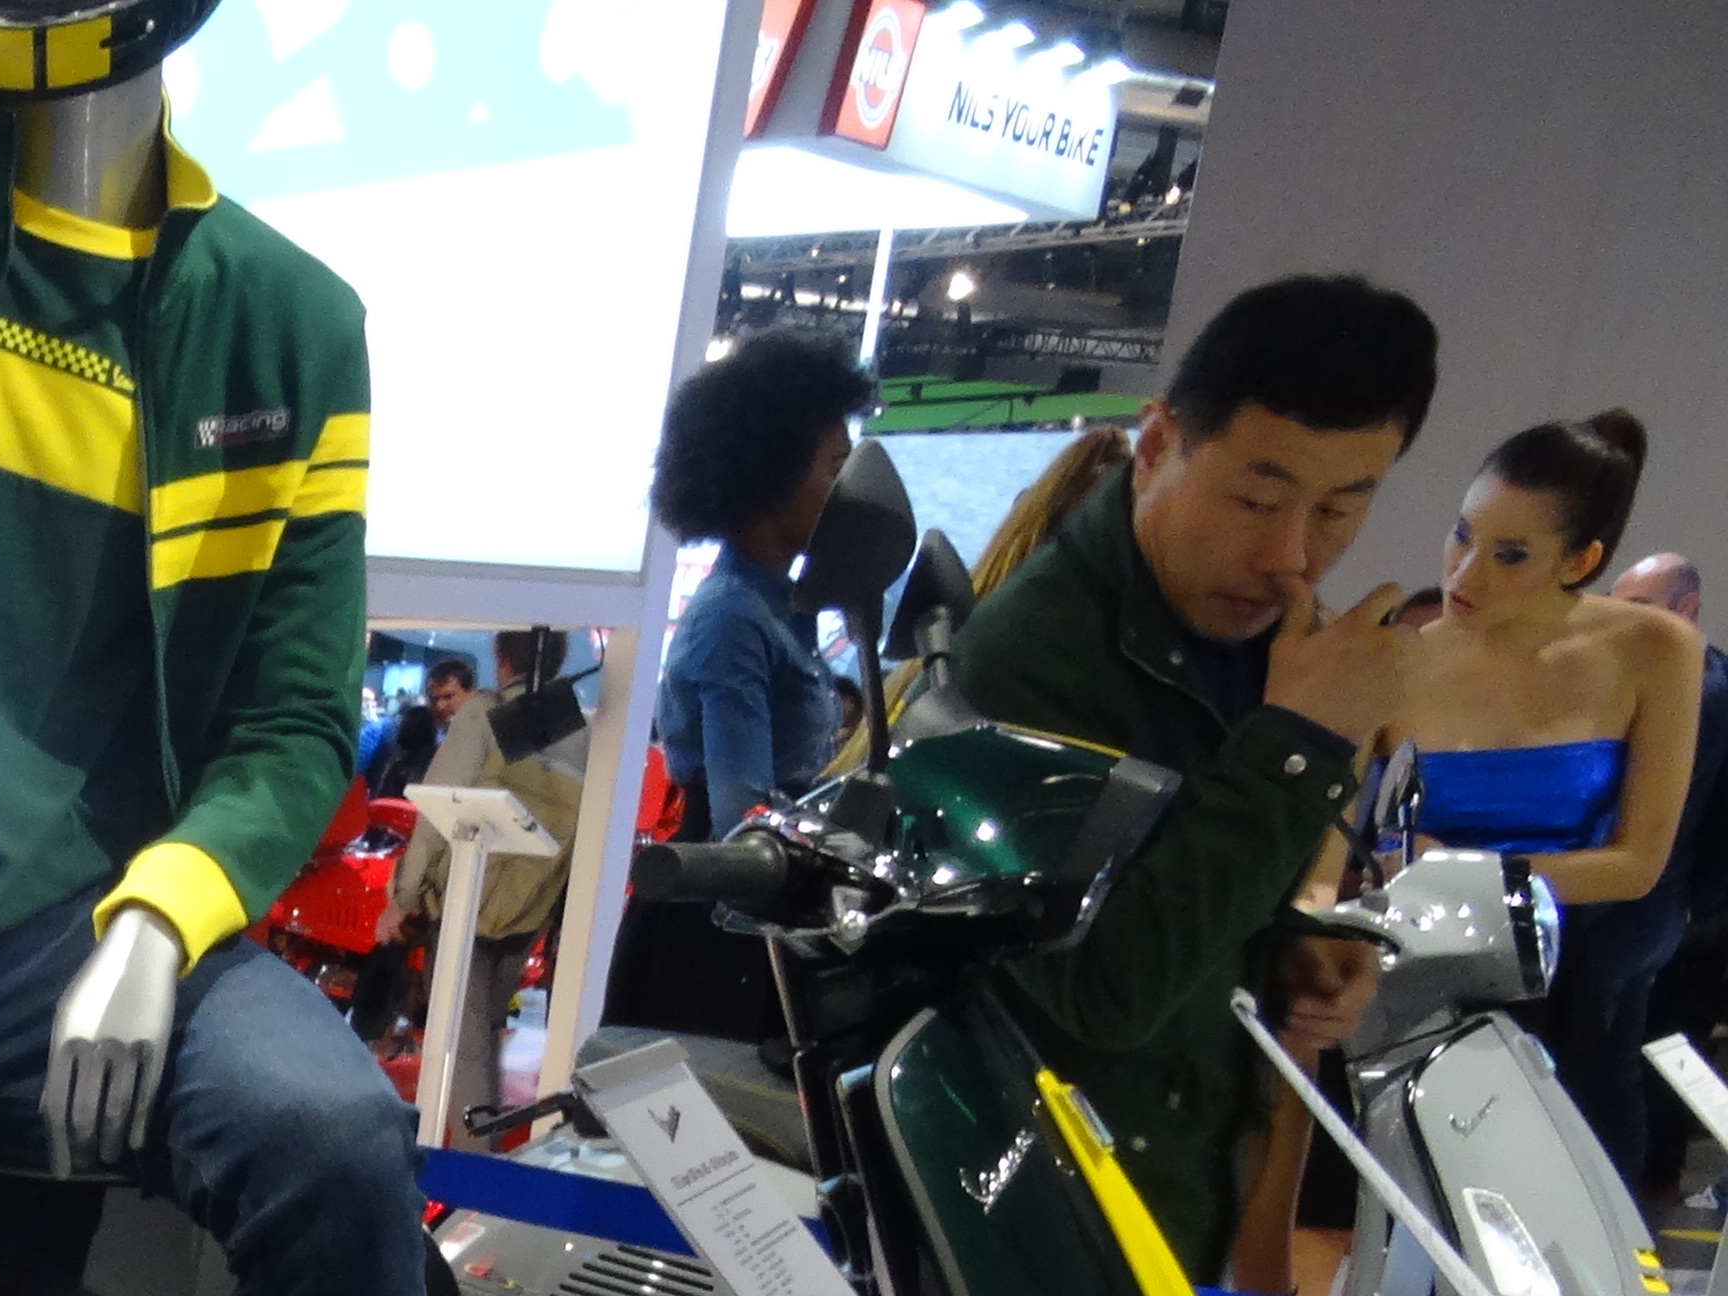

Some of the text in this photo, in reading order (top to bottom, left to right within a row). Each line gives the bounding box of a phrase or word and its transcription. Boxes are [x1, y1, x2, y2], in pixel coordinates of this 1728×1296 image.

[948, 81, 1103, 166] NILS YOUR BIKE
